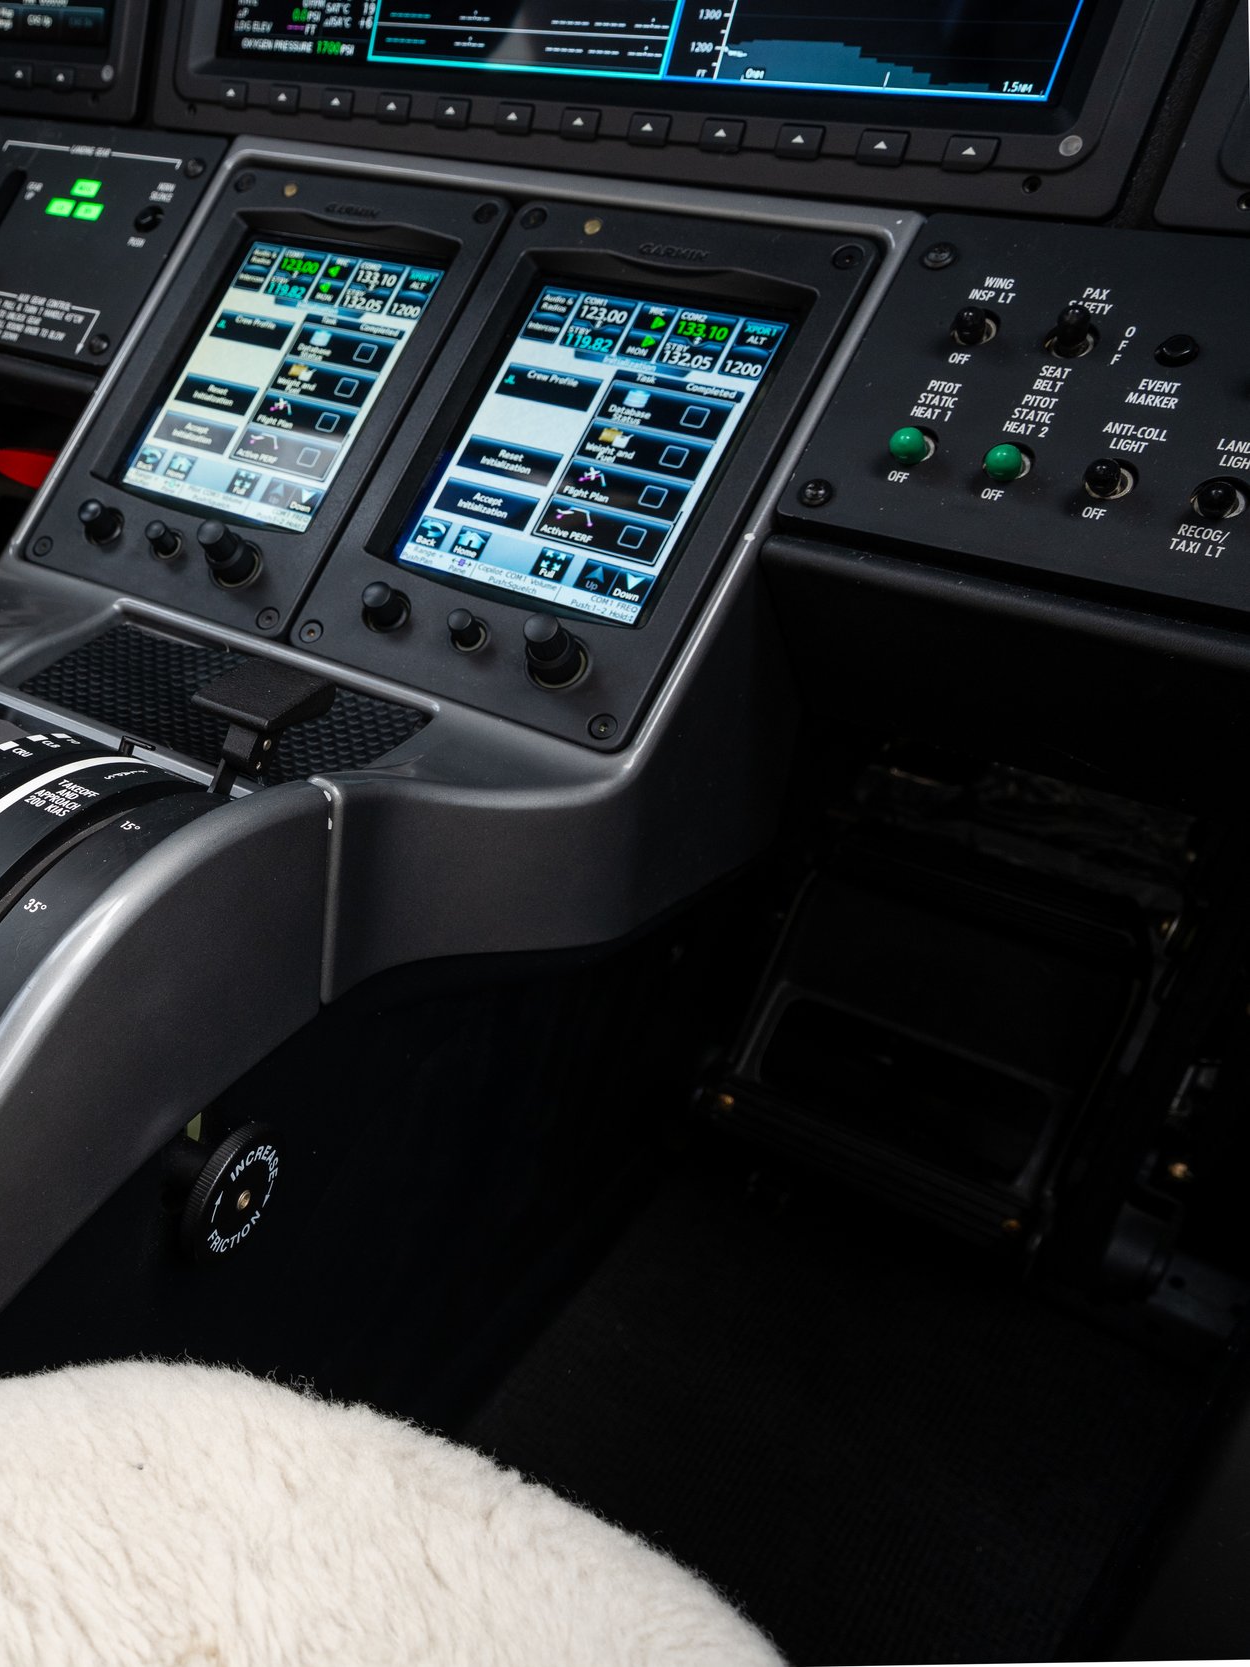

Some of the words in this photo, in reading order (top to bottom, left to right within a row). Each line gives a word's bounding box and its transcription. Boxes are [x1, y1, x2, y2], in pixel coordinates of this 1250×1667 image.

[699, 9, 722, 20] 1300
[241, 37, 273, 50] OXYGEN
[274, 39, 313, 54] PRESSURE
[690, 41, 713, 53] 1200
[637, 242, 710, 260] GARMIN
[280, 257, 320, 275] 123.00
[355, 268, 398, 288] 133.10
[984, 276, 1015, 291] WING
[267, 281, 306, 299] 119.82
[409, 281, 426, 291] ALT
[543, 294, 567, 305] Audio
[583, 296, 608, 307] COM1
[968, 289, 996, 302] INSP
[997, 292, 1016, 304] LT
[1082, 287, 1111, 301] PAX
[342, 295, 384, 313] 132.05
[390, 302, 421, 319] 1200
[541, 301, 568, 313] Radios
[648, 306, 667, 317] MIC
[1068, 300, 1113, 315] FETY
[235, 314, 253, 326] Crew
[251, 319, 276, 330] Profile
[579, 305, 628, 324] 123.00
[680, 311, 707, 322] COM2
[359, 323, 399, 338] Completed
[527, 321, 561, 334] Intercom
[568, 325, 591, 336] STBY
[675, 321, 729, 342] 133.10
[744, 324, 777, 337] XPDR1
[564, 333, 614, 352] 119.82
[665, 341, 690, 352] STBY
[746, 335, 768, 346] ALT
[626, 345, 649, 357] MON
[948, 352, 971, 365] OFF
[603, 355, 657, 372] Initialization
[660, 349, 713, 371] 132.05
[723, 359, 762, 378] 1200
[1039, 365, 1072, 380] SEAT
[527, 370, 551, 382] Crew
[549, 374, 579, 388] Profile
[635, 373, 656, 385] Task
[1032, 379, 1064, 393] BELT
[1138, 378, 1181, 395] EVENT
[207, 384, 229, 396] Reset
[685, 382, 738, 399] Completed
[927, 379, 962, 395] PITOT
[192, 391, 234, 407] Initialization
[918, 392, 959, 409] STATIC
[1021, 394, 1058, 409] PITOT
[1125, 392, 1179, 410] MARKER
[608, 403, 651, 420] Database
[611, 412, 641, 426] Status
[910, 405, 943, 420] HEAT
[944, 410, 953, 422] 1
[1011, 407, 1055, 424] STATIC
[184, 422, 210, 435] Accept
[256, 414, 276, 426] Flight
[275, 418, 294, 429] Plan
[171, 429, 213, 445] Initialization
[1002, 421, 1035, 437] HEAT
[1038, 426, 1049, 438] 2
[1103, 421, 1168, 442] ANTI-COLL
[585, 442, 616, 458] Weight
[615, 448, 636, 460] and
[1109, 437, 1148, 455] LIGHT
[236, 448, 261, 461] Active
[261, 454, 278, 465] PERF
[498, 448, 525, 463] Reset
[595, 452, 616, 464] Fuel
[479, 456, 531, 476] Initialization
[165, 468, 186, 480] Home
[888, 470, 909, 483] OFF
[472, 492, 504, 508] Accept
[562, 485, 589, 498] Flight
[588, 491, 610, 504] Plan
[981, 488, 1004, 501] OFF
[288, 501, 312, 514] Down
[457, 498, 508, 520] Initialization
[1082, 506, 1106, 520] OFF
[540, 523, 570, 539] Active
[569, 530, 593, 544] PERF
[1177, 524, 1230, 544] RECOG/
[415, 535, 437, 548] Back
[1168, 538, 1202, 554] TAXI
[1205, 545, 1226, 558] LT
[453, 544, 478, 560] Home
[477, 563, 504, 579] Copilot
[529, 575, 557, 592] Volume
[538, 568, 556, 580] Full
[488, 576, 537, 596] Push:Squelch
[585, 581, 599, 592] Up
[612, 588, 640, 603] Down
[615, 600, 639, 614] FREQ
[42, 740, 61, 748] CLB
[12, 747, 33, 758] CRU
[55, 789, 79, 801] AND
[58, 779, 99, 799] TAKEOFF
[24, 795, 44, 809] 200
[45, 802, 71, 817] KIAS
[34, 789, 81, 812] APPROACH
[119, 820, 141, 832] 15°
[23, 898, 47, 913] 35°
[230, 1145, 278, 1182] INCREASE
[207, 1210, 261, 1253] FRICTION
